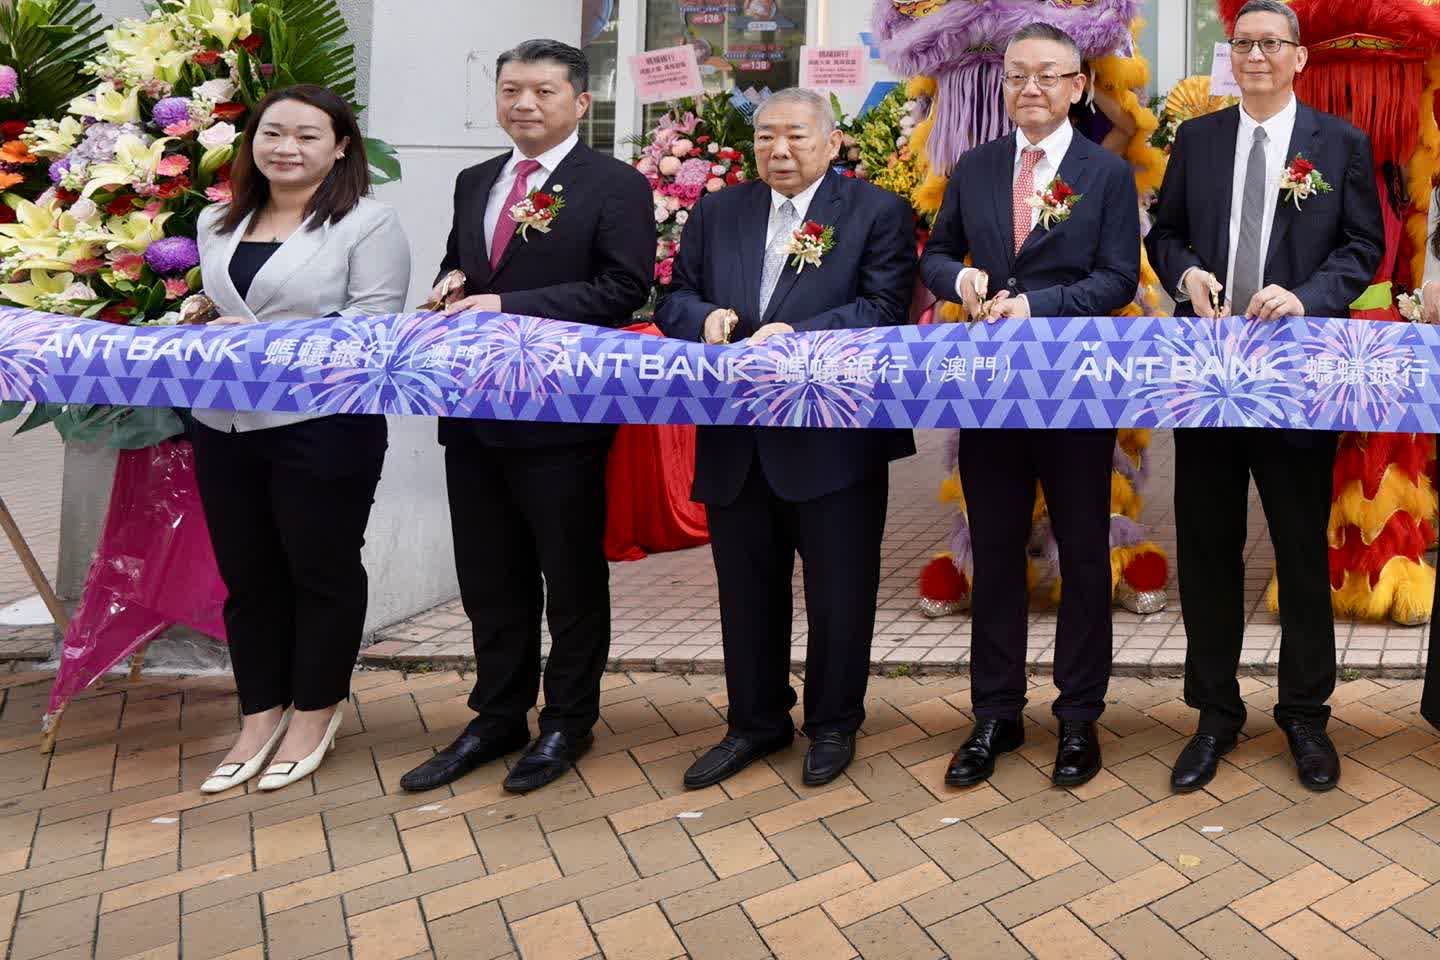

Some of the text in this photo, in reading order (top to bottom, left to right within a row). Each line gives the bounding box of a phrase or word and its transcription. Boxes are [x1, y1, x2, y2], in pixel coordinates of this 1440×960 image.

[125, 336, 249, 363] BANK
[637, 353, 756, 385] BANK
[1167, 355, 1287, 382] BANK
